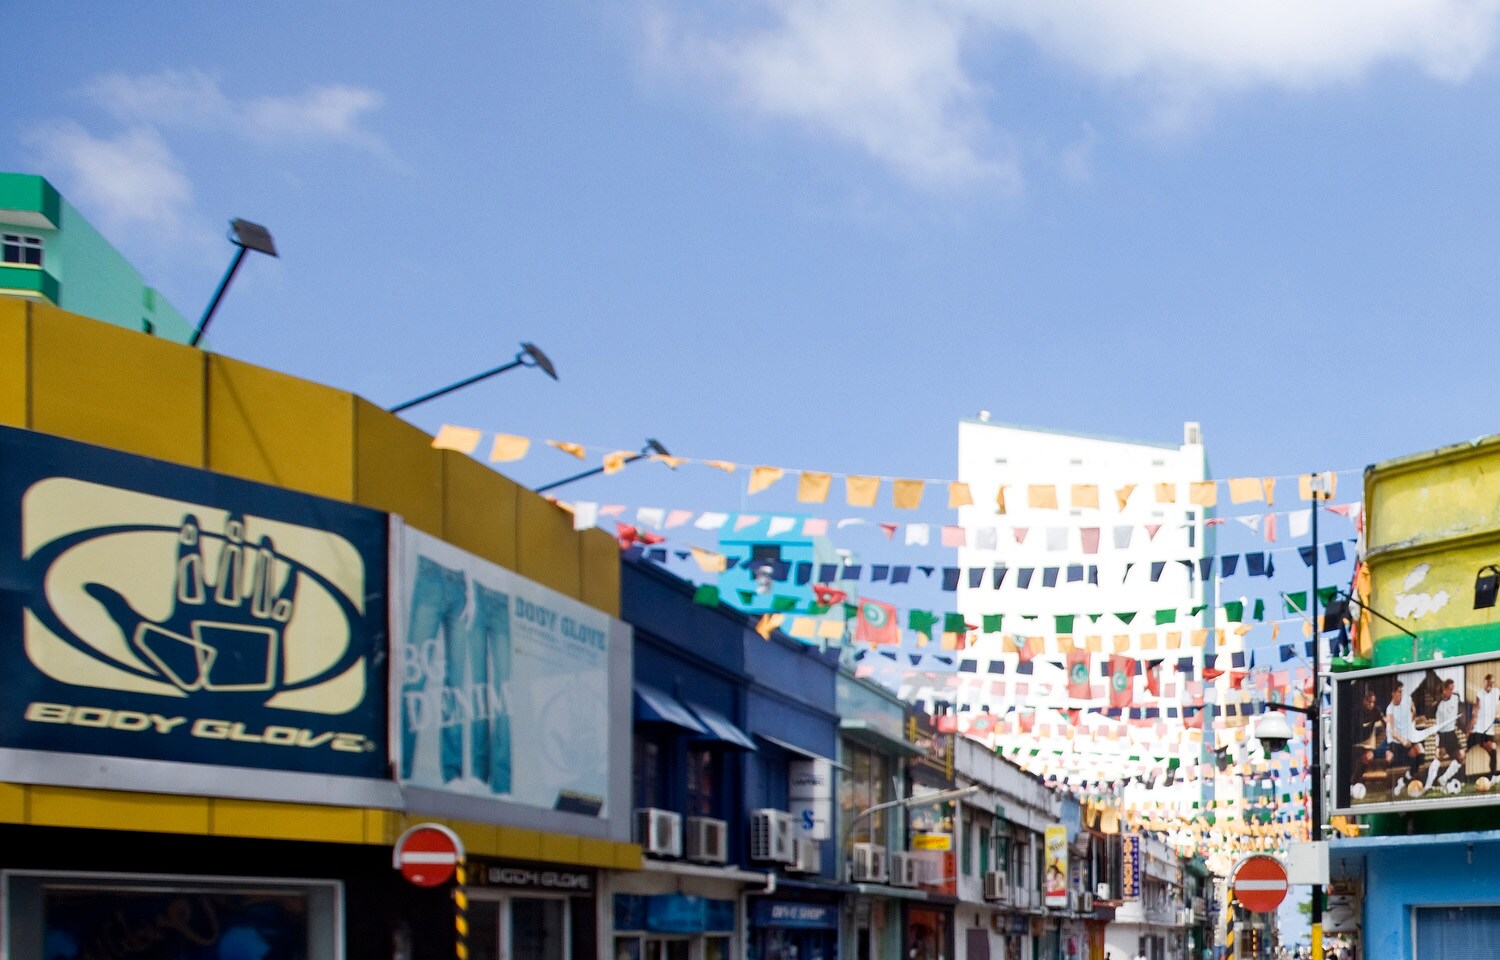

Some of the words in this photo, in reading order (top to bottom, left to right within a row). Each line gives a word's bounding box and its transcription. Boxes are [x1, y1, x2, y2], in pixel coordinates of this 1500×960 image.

[514, 597, 558, 630] BODY
[560, 616, 606, 650] GLOVE
[24, 701, 188, 735] BODY
[190, 717, 367, 752] GLOVE
